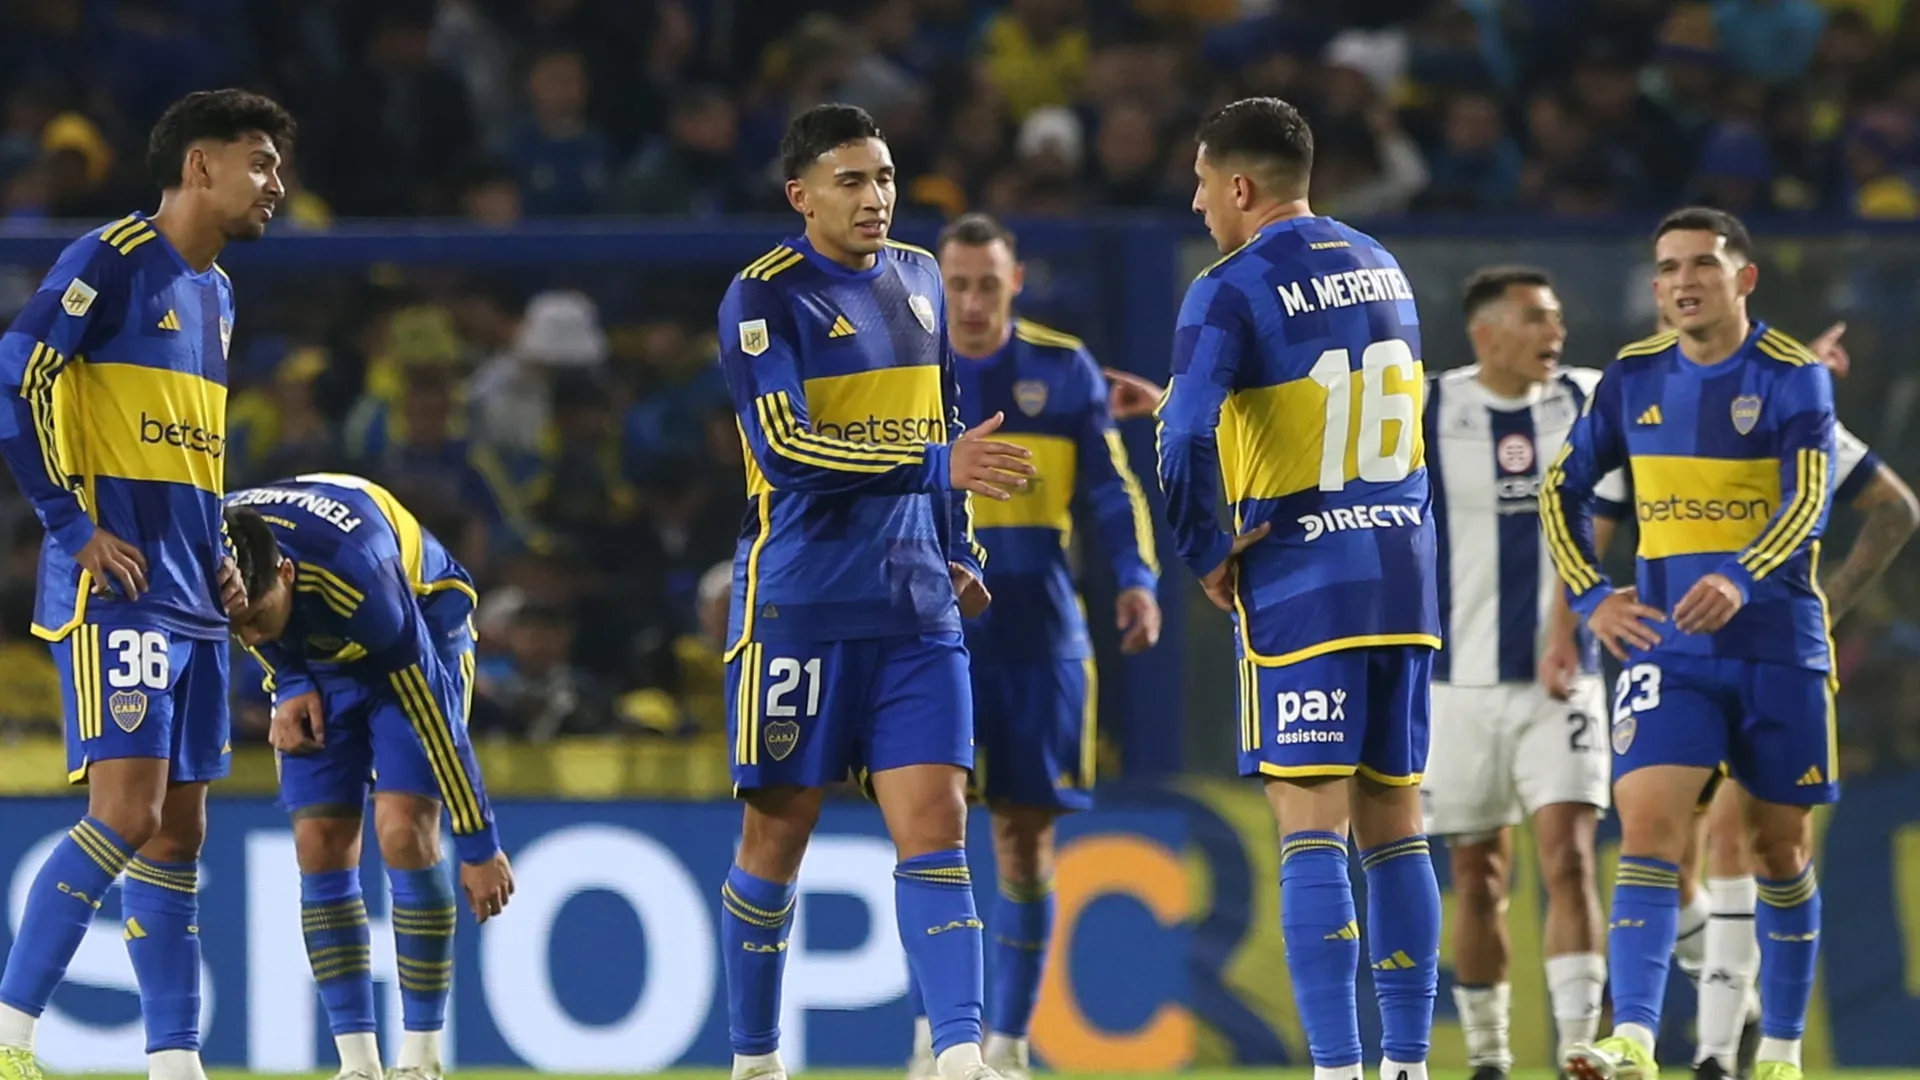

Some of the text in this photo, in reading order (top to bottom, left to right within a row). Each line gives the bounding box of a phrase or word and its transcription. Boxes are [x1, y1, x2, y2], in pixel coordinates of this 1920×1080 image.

[1277, 267, 1414, 317] M. MERENTIEL
[141, 411, 227, 458] betsso
[1309, 339, 1414, 491] 16
[228, 487, 362, 533] FERNANDEZ
[1297, 504, 1422, 542] DIRECTV
[108, 629, 169, 690] 36
[114, 703, 142, 714] CABJ
[766, 657, 821, 717] 21
[1277, 688, 1347, 731] pax
[1613, 663, 1662, 726] 23
